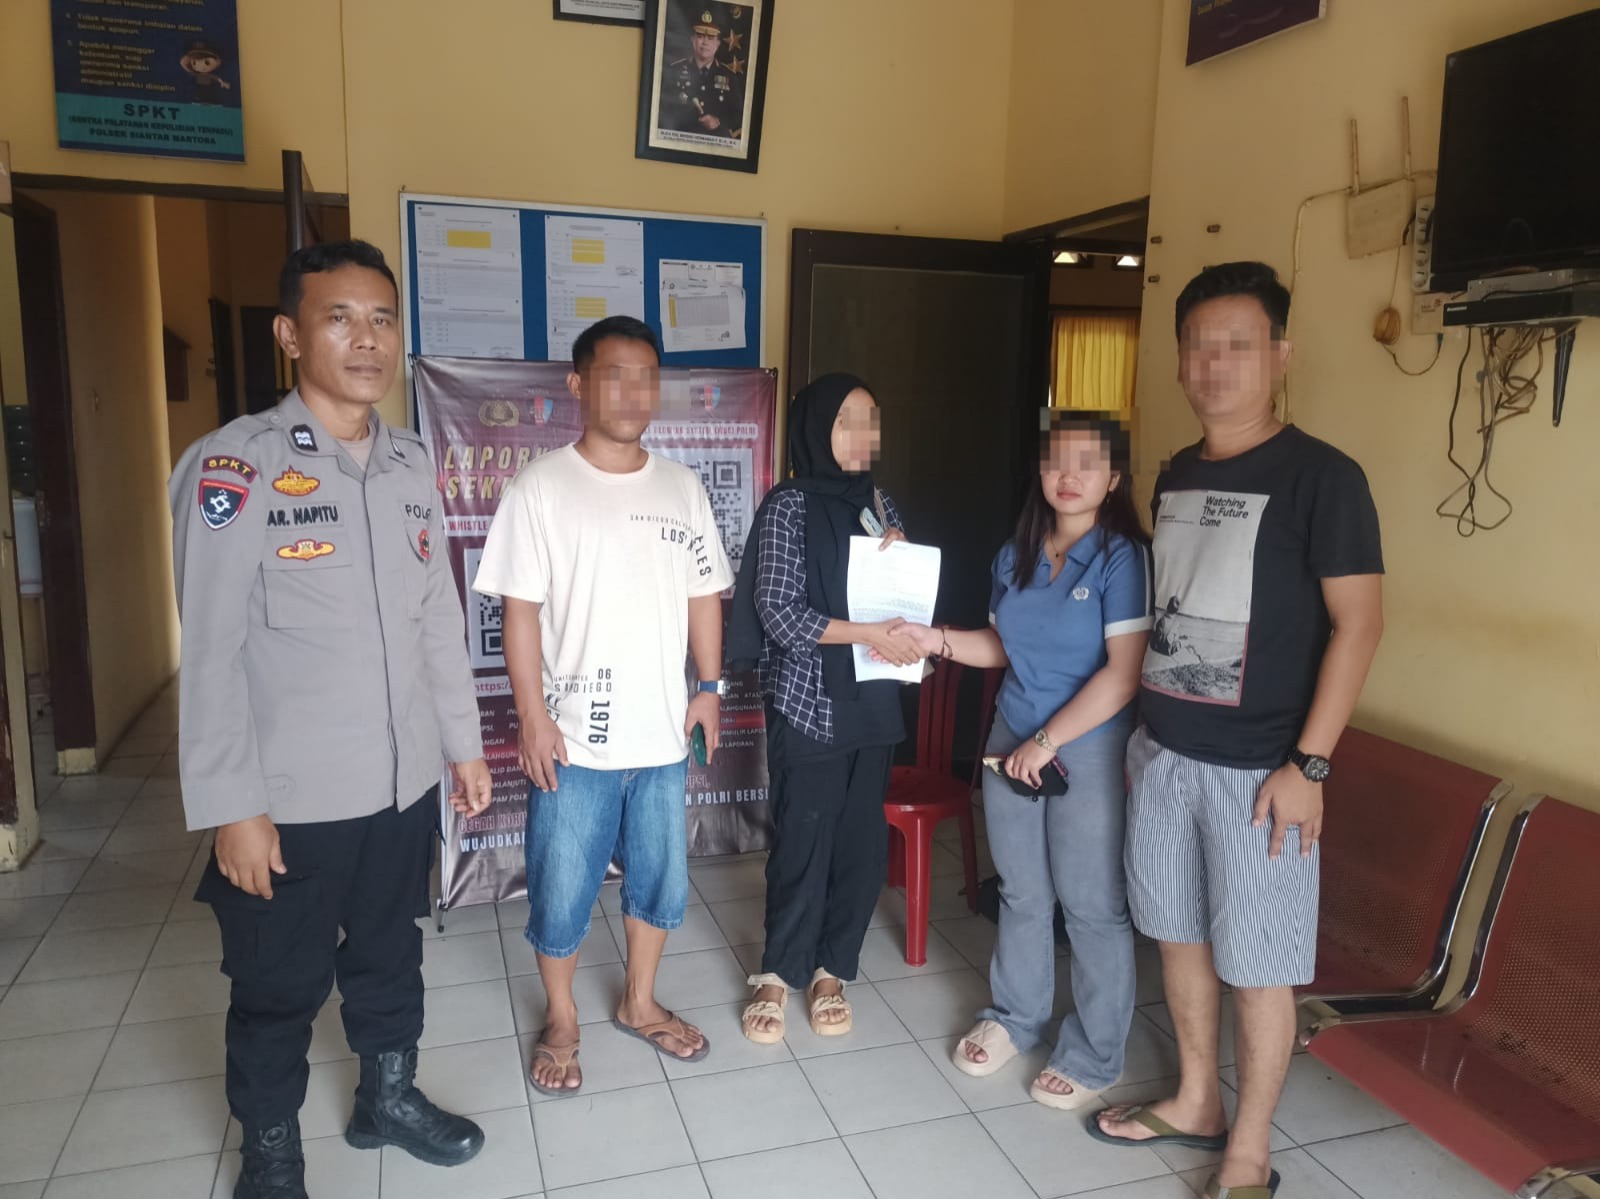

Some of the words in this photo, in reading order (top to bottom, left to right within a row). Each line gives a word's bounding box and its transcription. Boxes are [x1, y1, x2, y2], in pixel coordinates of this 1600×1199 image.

[123, 103, 180, 121] SPKT
[89, 128, 127, 138] POLSEK
[130, 131, 170, 142] SIANTAR
[208, 458, 251, 474] SPKT
[1206, 495, 1246, 509] Watching
[267, 509, 290, 527] AR.
[293, 505, 339, 525] NAPITU
[1202, 506, 1216, 516] The
[1217, 508, 1249, 519] Future
[448, 520, 488, 531] WHISTLE
[1199, 517, 1222, 528] Come
[661, 527, 685, 544] LOS
[598, 668, 612, 680] 06
[573, 682, 612, 693] DIEGO
[588, 700, 611, 744] 1976
[725, 740, 754, 748] LAPORAN
[698, 790, 730, 805] POLRI
[459, 815, 496, 833] CEGAH
